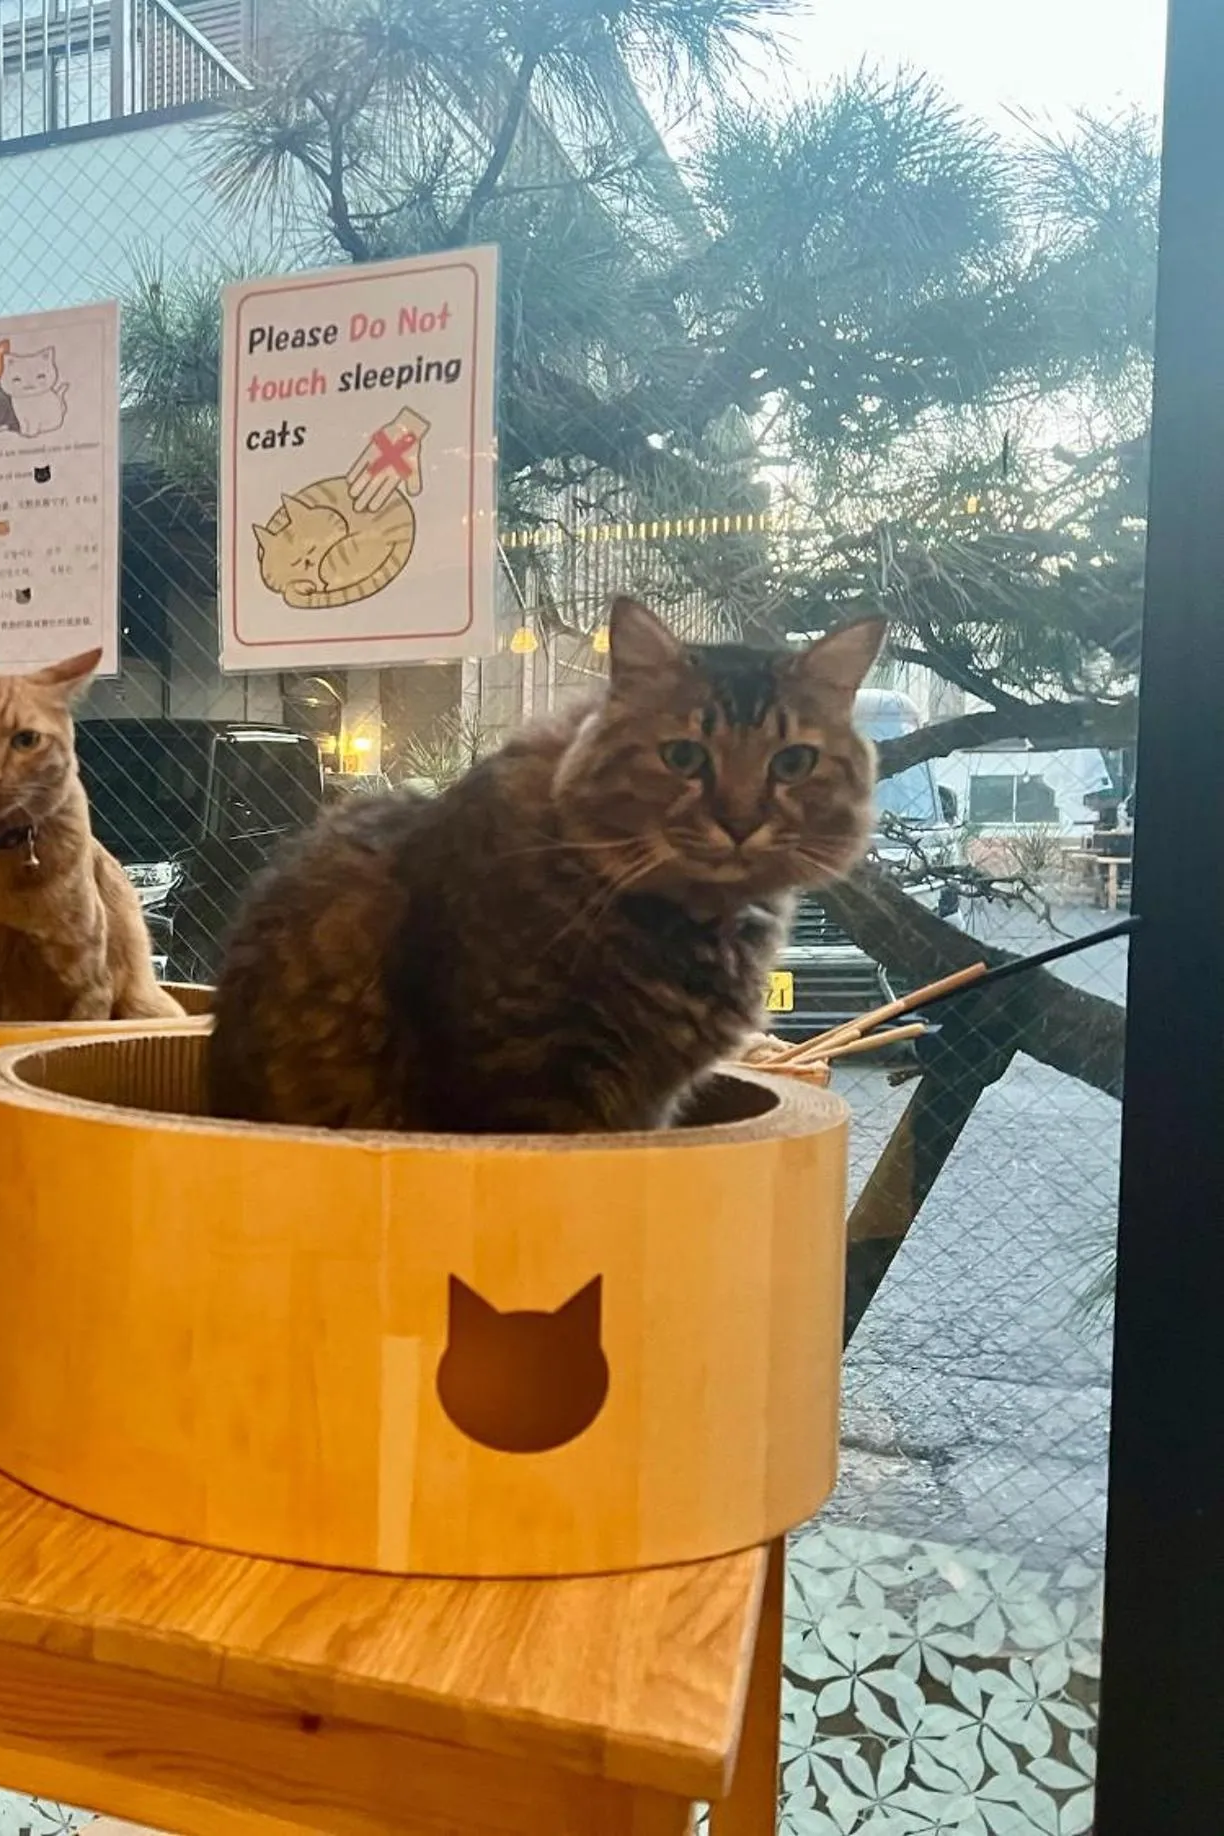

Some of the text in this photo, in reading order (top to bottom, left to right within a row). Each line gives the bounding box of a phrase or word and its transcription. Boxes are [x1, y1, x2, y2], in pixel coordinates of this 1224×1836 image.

[248, 302, 452, 354] Please Do Not
[246, 355, 462, 403] touch sleeping
[246, 420, 307, 451] cats
